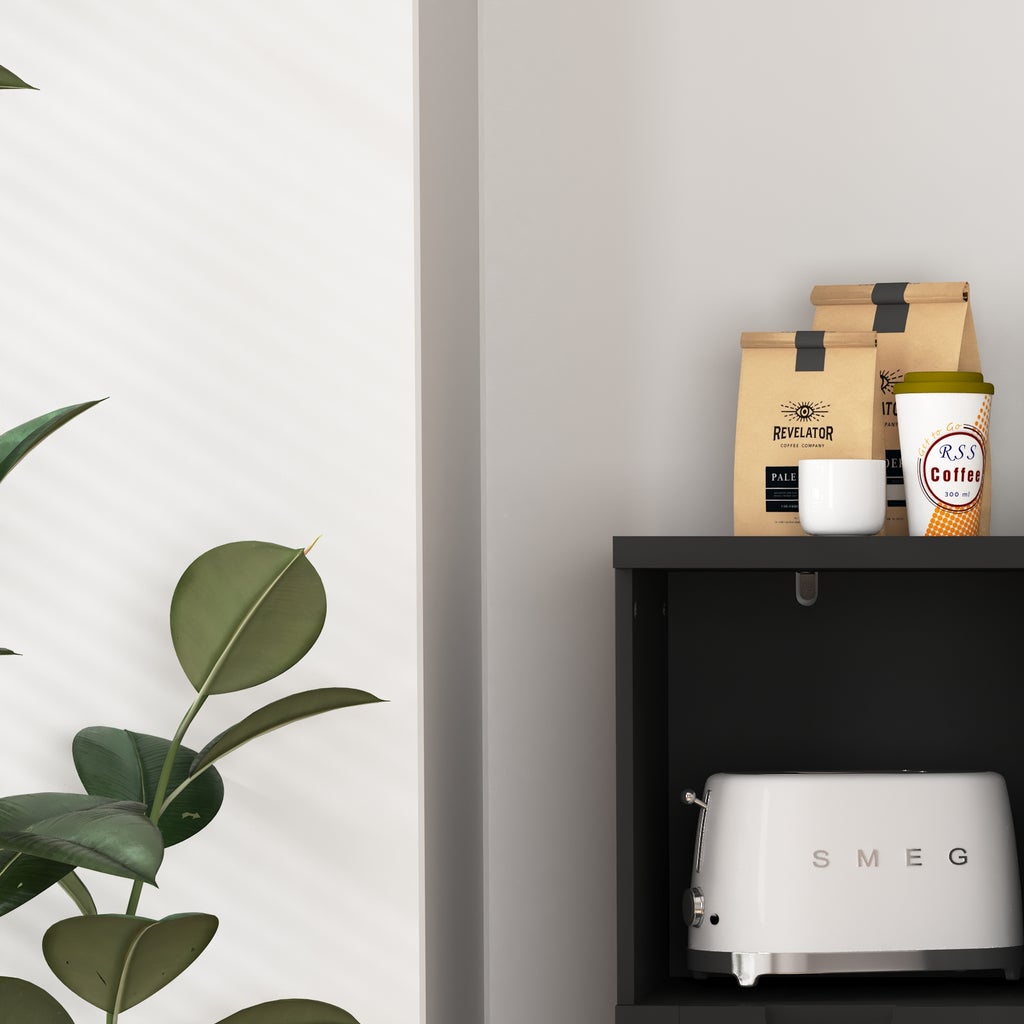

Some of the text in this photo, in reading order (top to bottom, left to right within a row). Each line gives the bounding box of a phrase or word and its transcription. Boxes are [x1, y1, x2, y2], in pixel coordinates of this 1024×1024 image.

[773, 426, 834, 441] REVELATOR
[946, 422, 962, 432] Go
[939, 444, 977, 461] RSS
[771, 473, 797, 482] PALE
[931, 467, 981, 482] Coffee
[812, 847, 968, 868] SMEG
